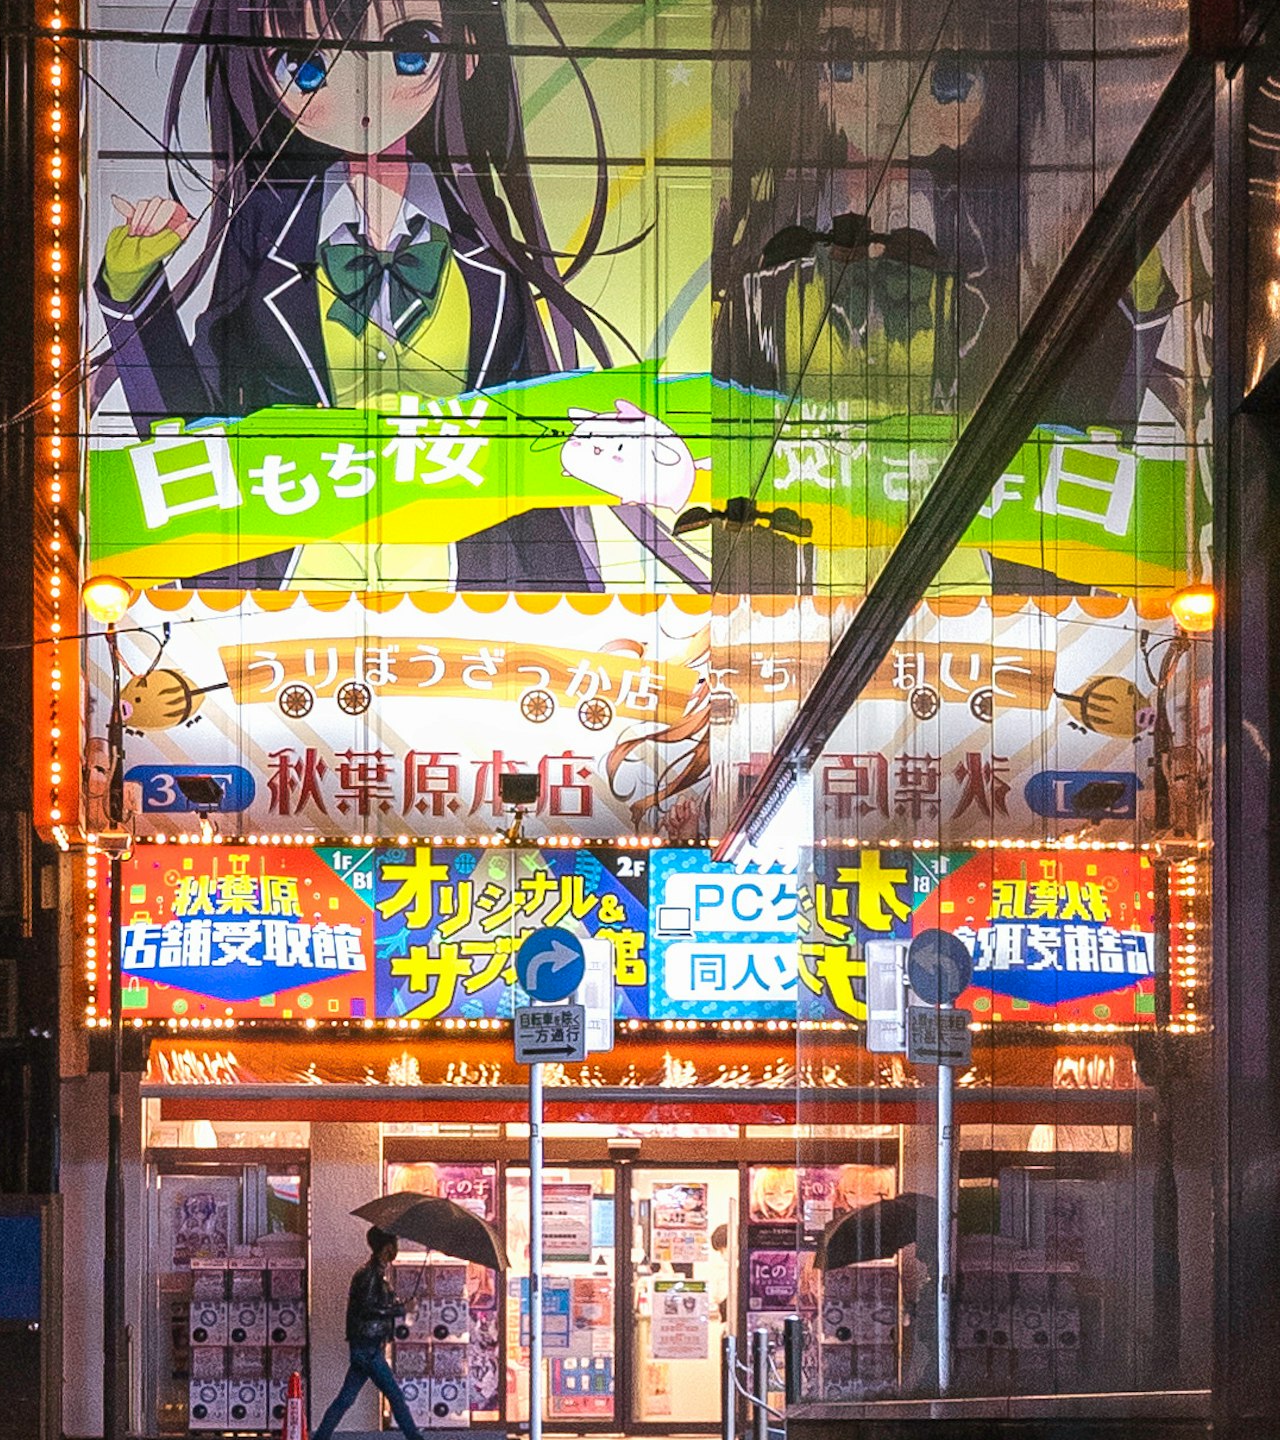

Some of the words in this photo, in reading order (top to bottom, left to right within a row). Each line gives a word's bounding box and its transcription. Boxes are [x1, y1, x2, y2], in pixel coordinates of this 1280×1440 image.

[130, 394, 491, 530] 白もち桜
[248, 643, 666, 712] うりぼうざっか店
[266, 746, 597, 818] 秋葉原本店
[616, 856, 646, 878] 2F
[171, 874, 304, 917] 秋葉原
[120, 918, 367, 971] 店舗受取館
[520, 1025, 580, 1043] 一方通行
